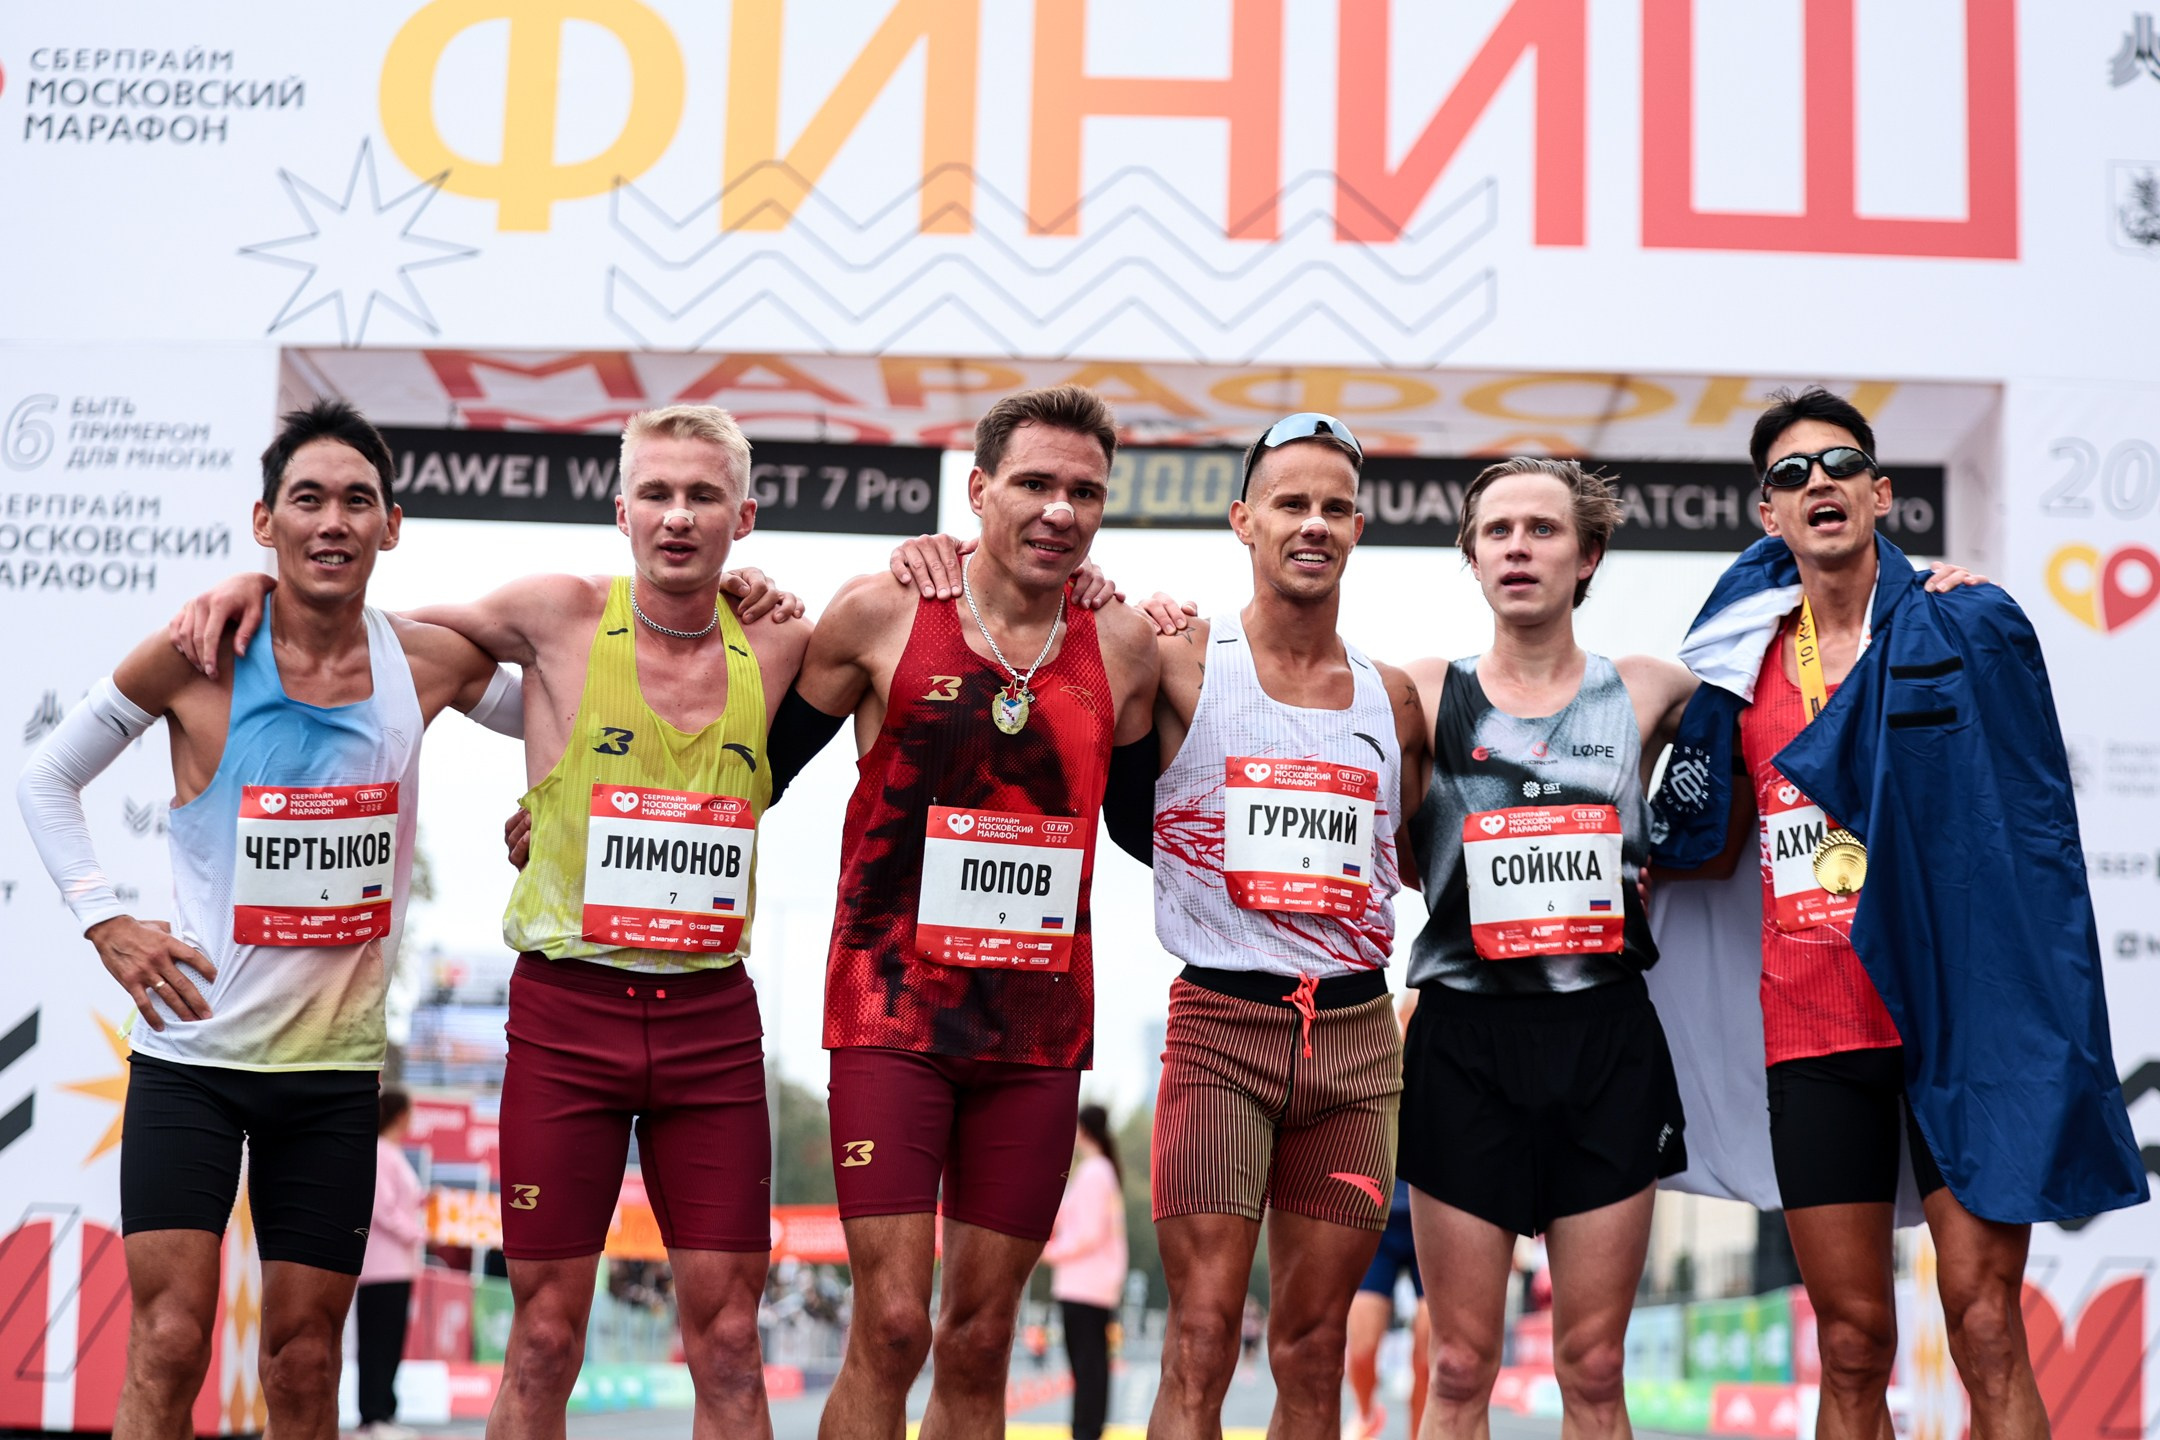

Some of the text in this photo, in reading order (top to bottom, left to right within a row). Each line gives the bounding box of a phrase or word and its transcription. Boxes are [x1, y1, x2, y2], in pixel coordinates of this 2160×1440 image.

[30, 46, 234, 72] СБЕРПРАЙМ
[27, 76, 305, 110] МОСКОВСКИЙ
[23, 114, 229, 145] МАРАФОН
[378, 0, 2018, 260] ФИНИШ
[72, 396, 137, 416] БЫТЬ
[69, 422, 211, 441] ПРИМЕРОМ
[66, 448, 233, 470] ДЛЯ МНОГИХ
[750, 464, 808, 508] GT
[818, 466, 848, 509] 7
[857, 468, 931, 513] Pro
[1620, 484, 1741, 530] ATCH
[0, 526, 231, 557] ОСКОВСКИЙ
[0, 563, 157, 592] АРАФОН
[1801, 646, 1814, 666] 10
[1275, 764, 1317, 772] СБЕРПРАЙМ
[1274, 771, 1332, 781] МОСКОВСКИЙ
[1342, 772, 1362, 782] 10 КМ
[1274, 777, 1317, 787] МАРАФОН
[1543, 783, 1561, 791] GST
[1342, 784, 1360, 793] 2026
[290, 792, 333, 800] СБЕРПРАЙМ
[359, 793, 370, 801] 10
[643, 793, 687, 803] СБЕРПРАЙМ
[290, 799, 348, 807] МОСКОВСКИЙ
[642, 800, 702, 812] МОСКОВСКИЙ
[641, 808, 686, 817] МАРАФОН
[713, 814, 736, 822] 2026
[1508, 811, 1550, 819] СБЕРПРАЙМ
[979, 815, 1020, 825] СБЕРПРАЙМ
[1249, 804, 1357, 845] ГУРЖИЙ
[1508, 816, 1566, 825] МОСКОВСКИЙ
[978, 823, 1034, 834] МОСКОВСКИЙ
[1046, 823, 1069, 832] 10 КМ
[1509, 825, 1551, 833] МАРАФОН
[977, 830, 1018, 840] МАРАФОН
[1045, 835, 1067, 843] 2026
[1776, 821, 1823, 861] АХМ
[246, 832, 391, 870] ЧЕРТЫКОВ
[601, 835, 742, 878] ЛИМОНОВ
[1302, 857, 1310, 868] 8
[1491, 846, 1602, 887] СОЙККА
[961, 858, 1052, 897] ПОПОВ
[320, 889, 329, 901] 4
[669, 892, 678, 904] 7
[1547, 901, 1554, 912] 6
[999, 912, 1006, 924] 9
